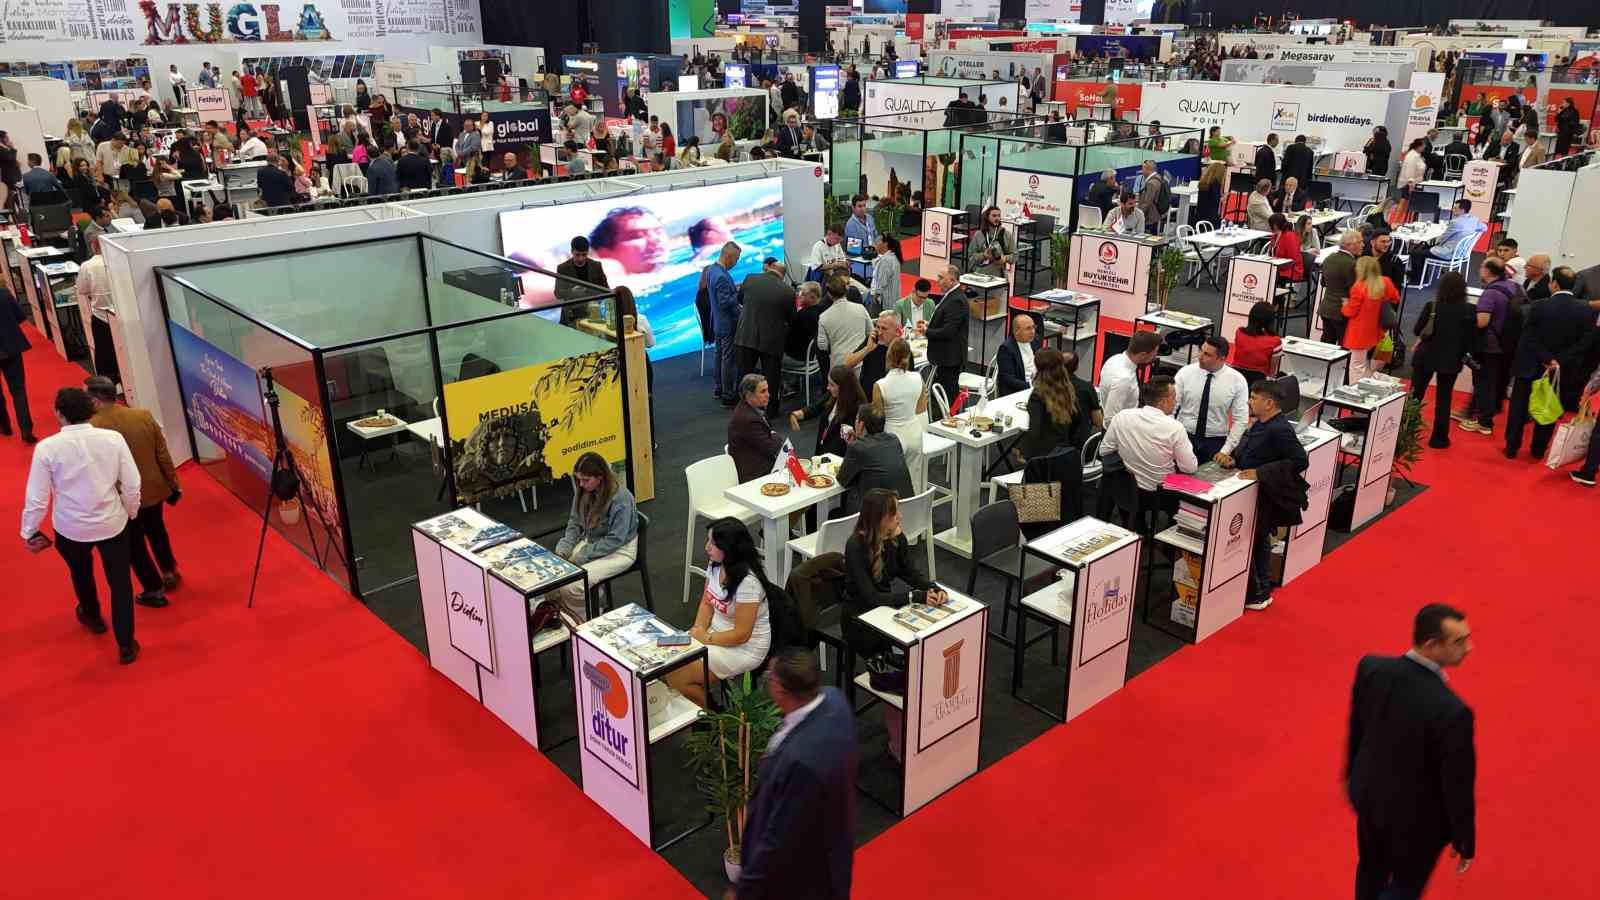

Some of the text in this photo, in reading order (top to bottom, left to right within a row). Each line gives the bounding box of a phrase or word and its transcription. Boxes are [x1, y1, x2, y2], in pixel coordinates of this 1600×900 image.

[884, 97, 936, 113] QUALITY
[1178, 98, 1240, 116] QUALITY
[497, 118, 539, 138] global
[897, 116, 925, 124] POINT
[1192, 117, 1225, 125] POINT
[478, 400, 539, 423] MEDUSA
[561, 434, 617, 456] godidim.com
[450, 591, 484, 626] Didim
[592, 710, 629, 757] ditur
